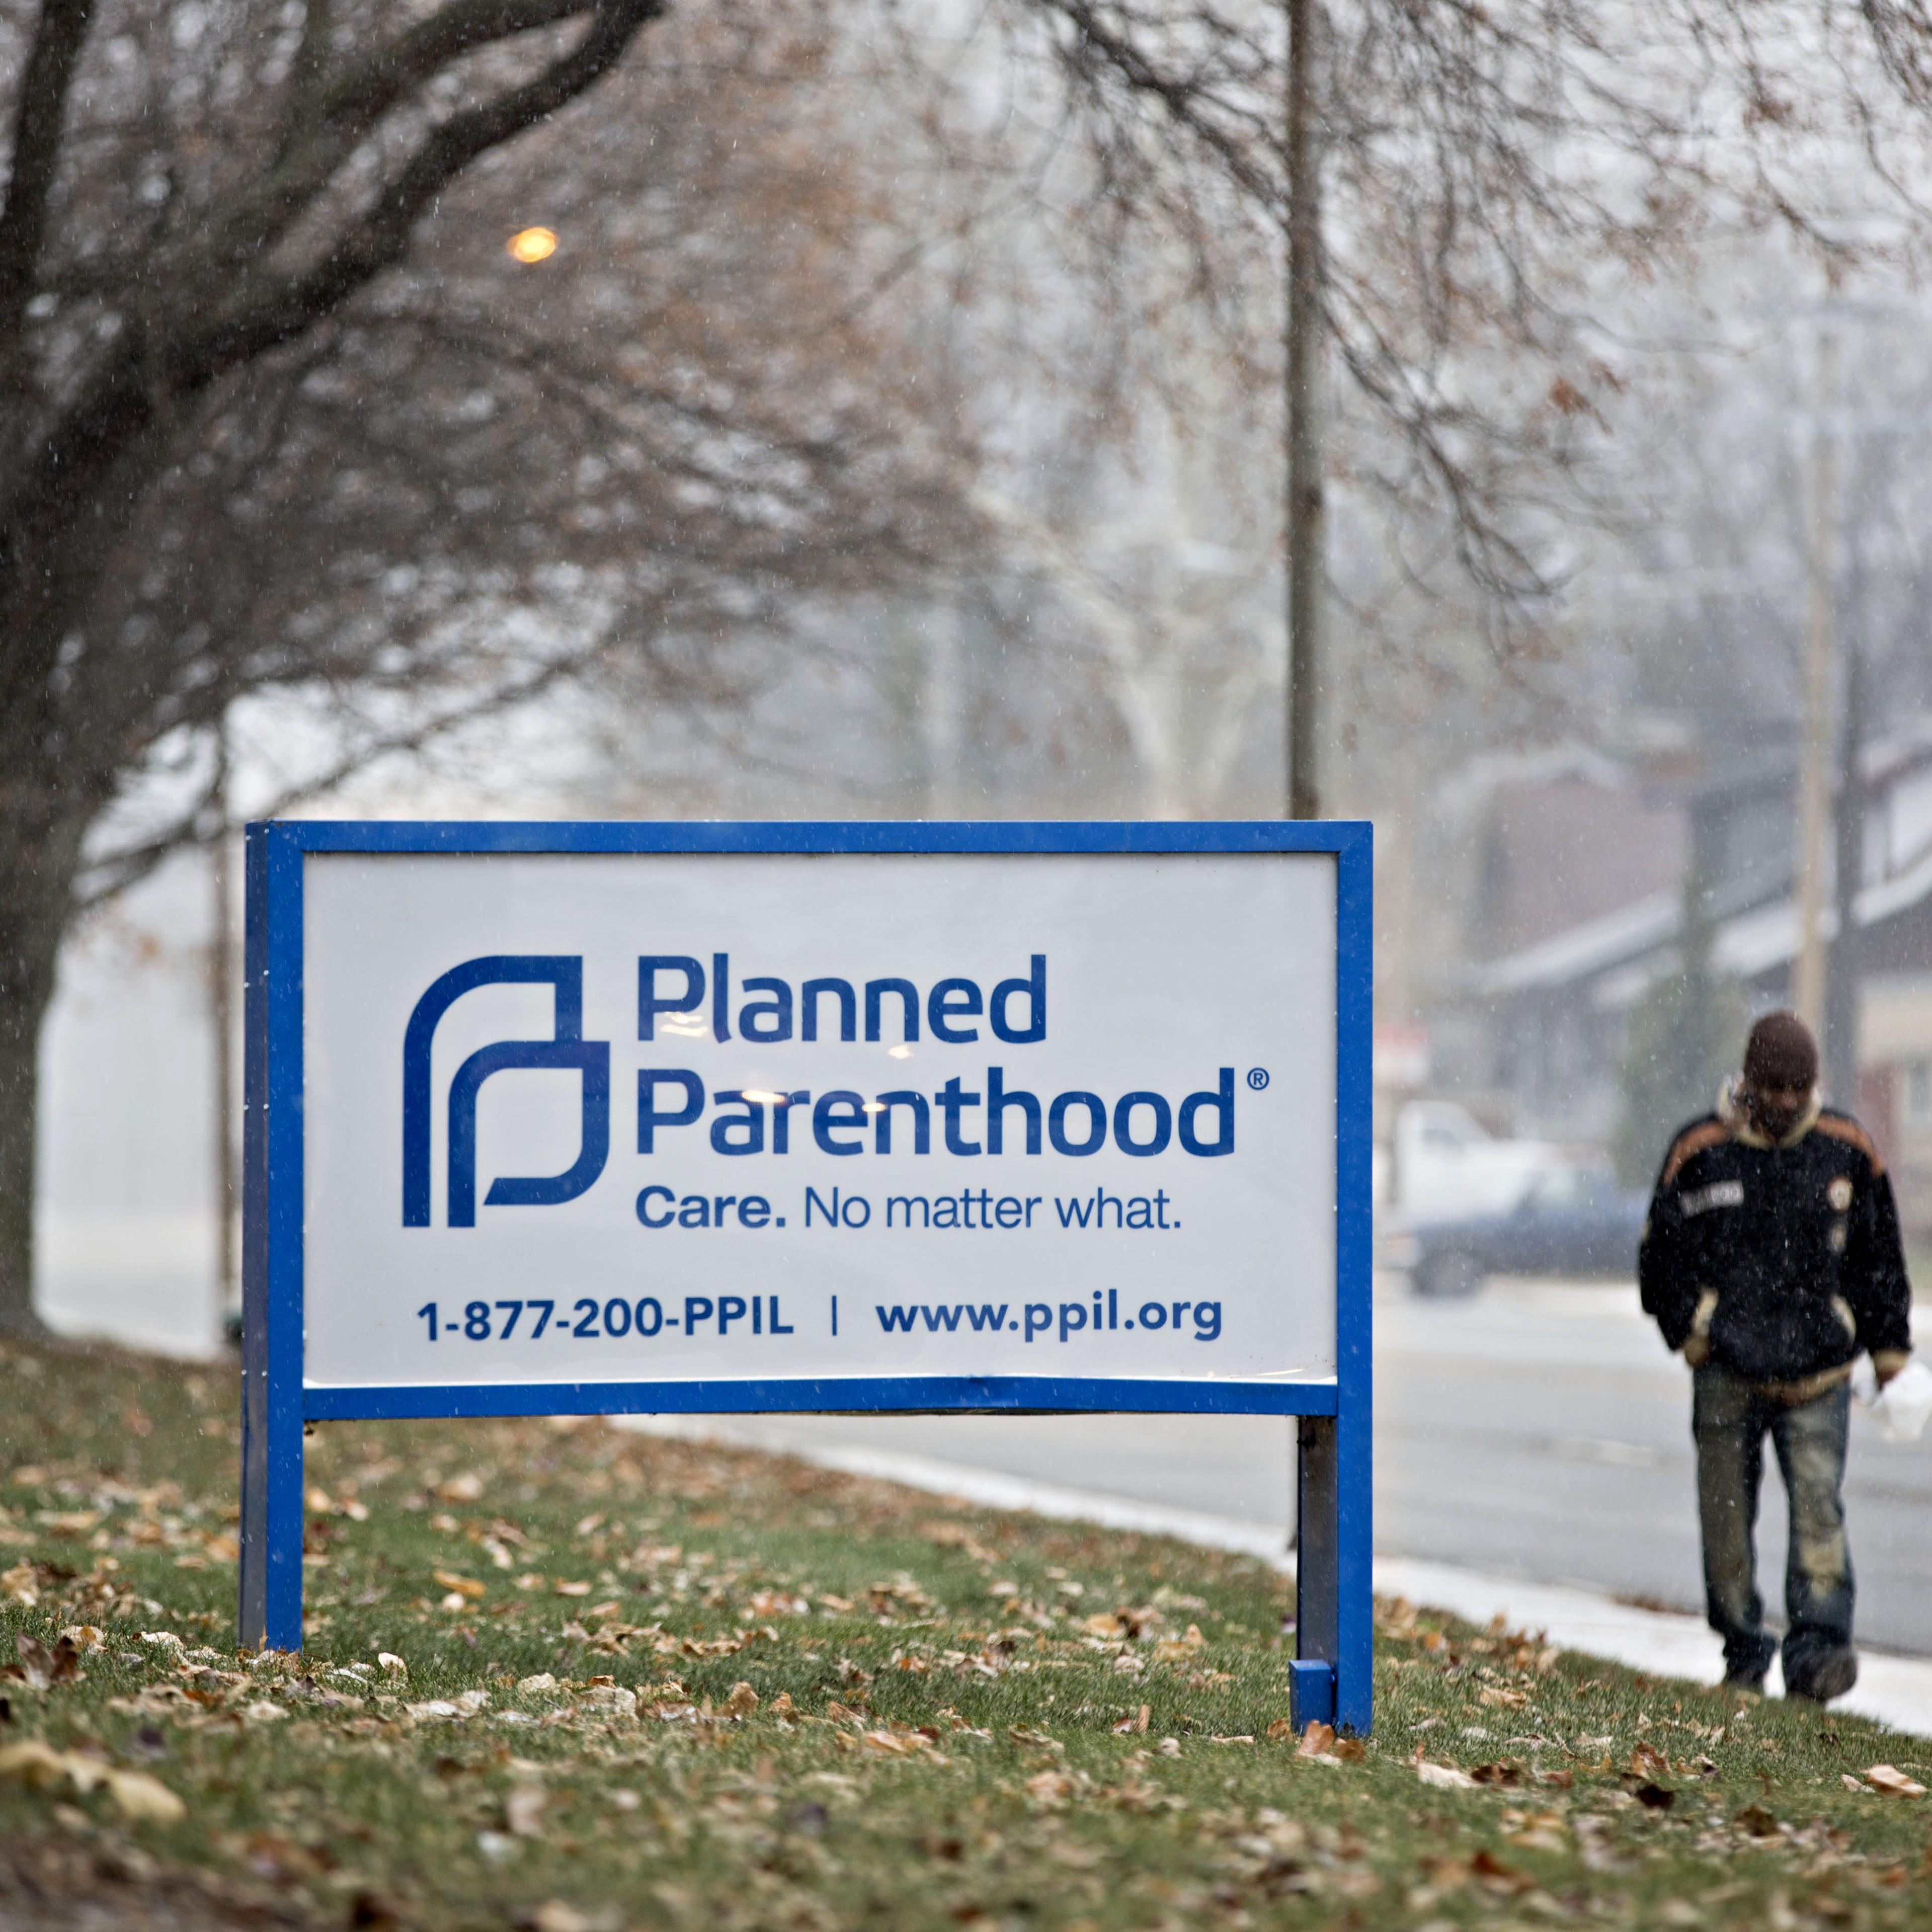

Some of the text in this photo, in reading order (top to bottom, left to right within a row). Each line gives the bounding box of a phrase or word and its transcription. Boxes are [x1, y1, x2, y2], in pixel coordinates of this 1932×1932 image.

[637, 952, 1046, 1044] Planned
[635, 1185, 1181, 1229] Care. No matter what.
[417, 1288, 1222, 1343] 1-877-200-PPIL www.ppil.org
